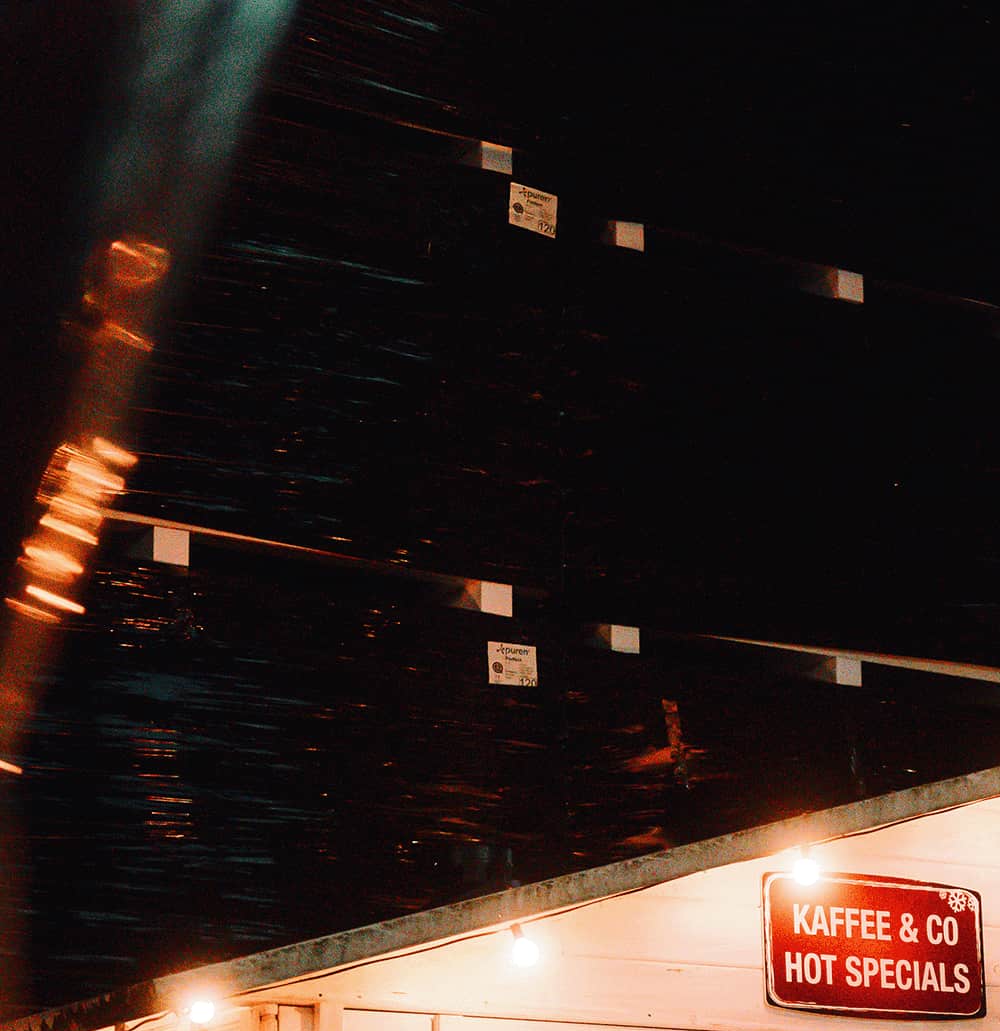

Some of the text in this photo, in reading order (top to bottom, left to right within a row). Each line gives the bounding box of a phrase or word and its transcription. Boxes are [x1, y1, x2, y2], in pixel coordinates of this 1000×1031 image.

[793, 903, 959, 946] KAFFEE & CO
[784, 951, 971, 994] HOT SPECIALS
